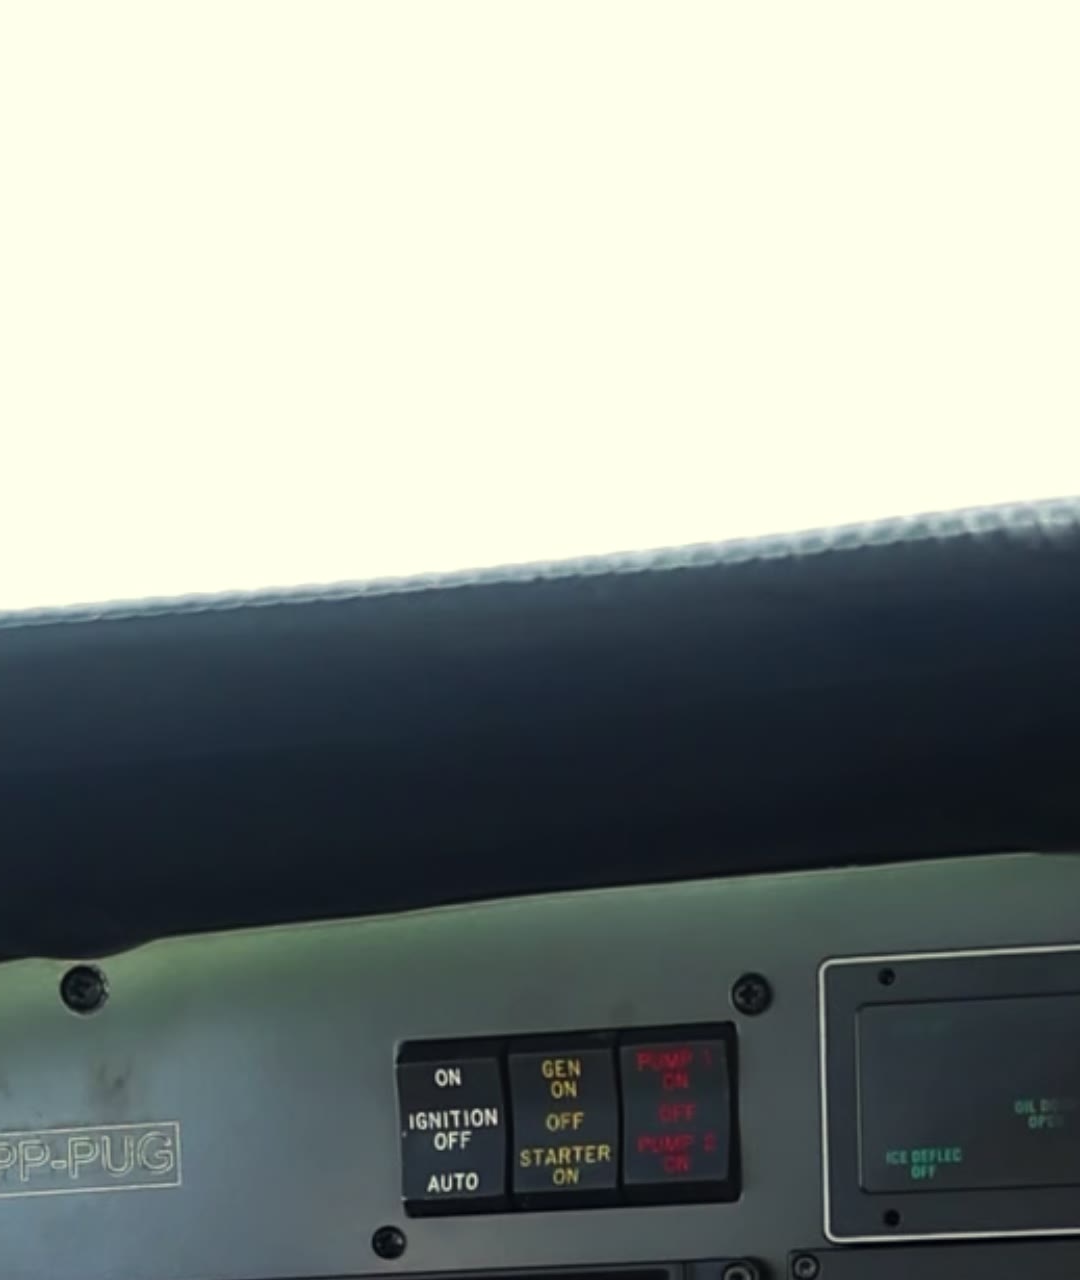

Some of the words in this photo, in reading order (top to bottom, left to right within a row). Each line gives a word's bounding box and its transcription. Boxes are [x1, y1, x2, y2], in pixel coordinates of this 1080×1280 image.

[541, 1059, 581, 1078] GEN
[637, 1050, 692, 1071] PUMP
[434, 1068, 461, 1087] ON
[551, 1079, 577, 1098] ON
[409, 1108, 498, 1130] IGNITION
[545, 1112, 584, 1131] OFF
[657, 1103, 695, 1122] OFF
[434, 1131, 471, 1150] OFF
[637, 1134, 692, 1153] PUMP
[520, 1145, 610, 1167] STARTER
[427, 1172, 479, 1192] AUTO
[553, 1166, 579, 1185] ON
